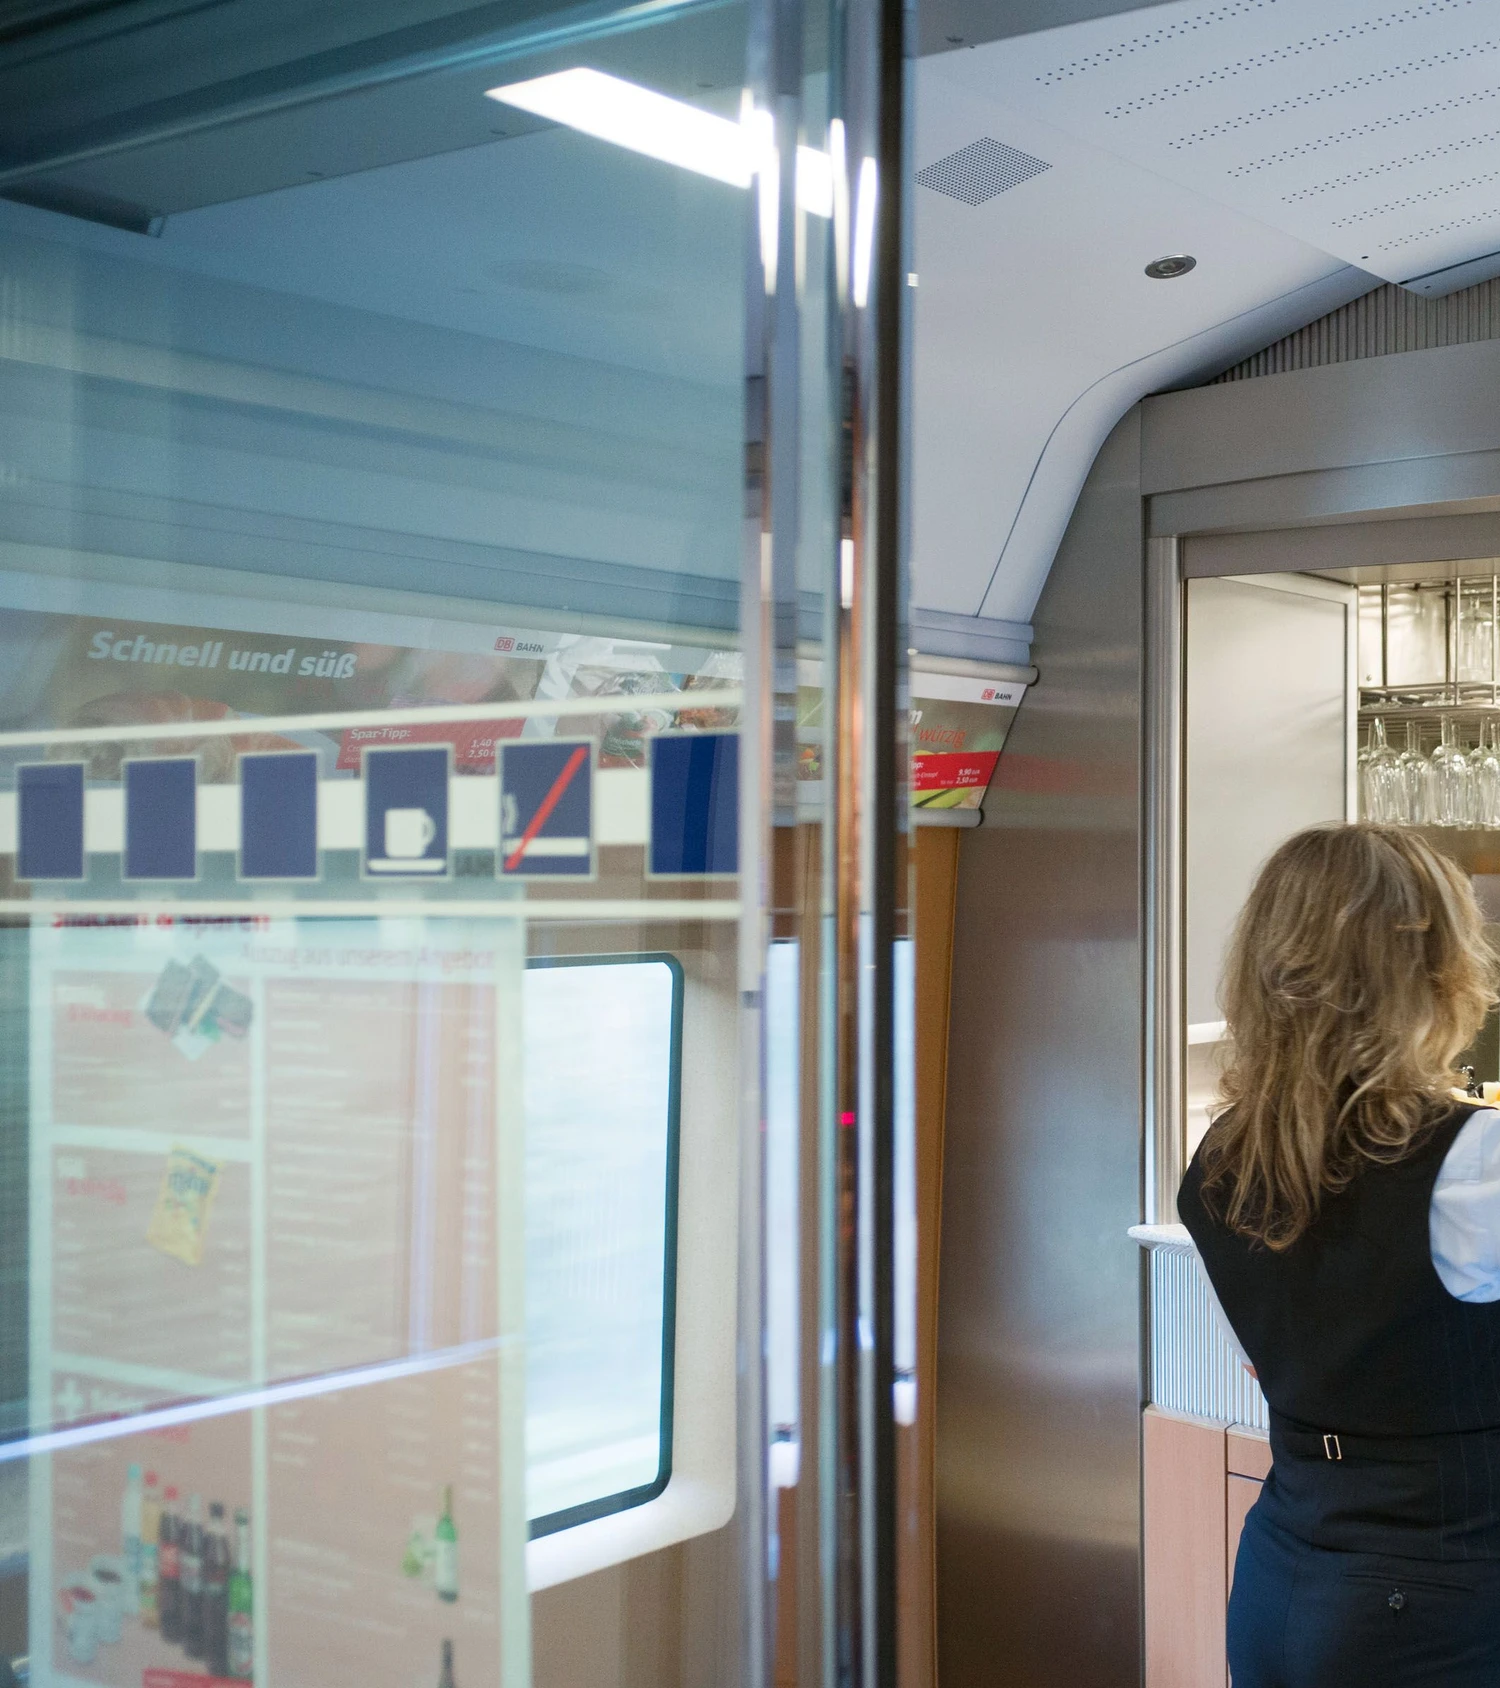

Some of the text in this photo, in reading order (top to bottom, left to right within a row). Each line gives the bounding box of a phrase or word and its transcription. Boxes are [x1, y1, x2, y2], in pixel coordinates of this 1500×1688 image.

[495, 638, 545, 653] DB BAHN
[87, 631, 358, 679] Schnell und süß
[982, 689, 1012, 700] DB BAHN
[350, 727, 412, 741] Spar-Tipp:
[920, 725, 966, 749] würzig
[471, 738, 492, 749] 1.40
[468, 749, 489, 758] 2.50
